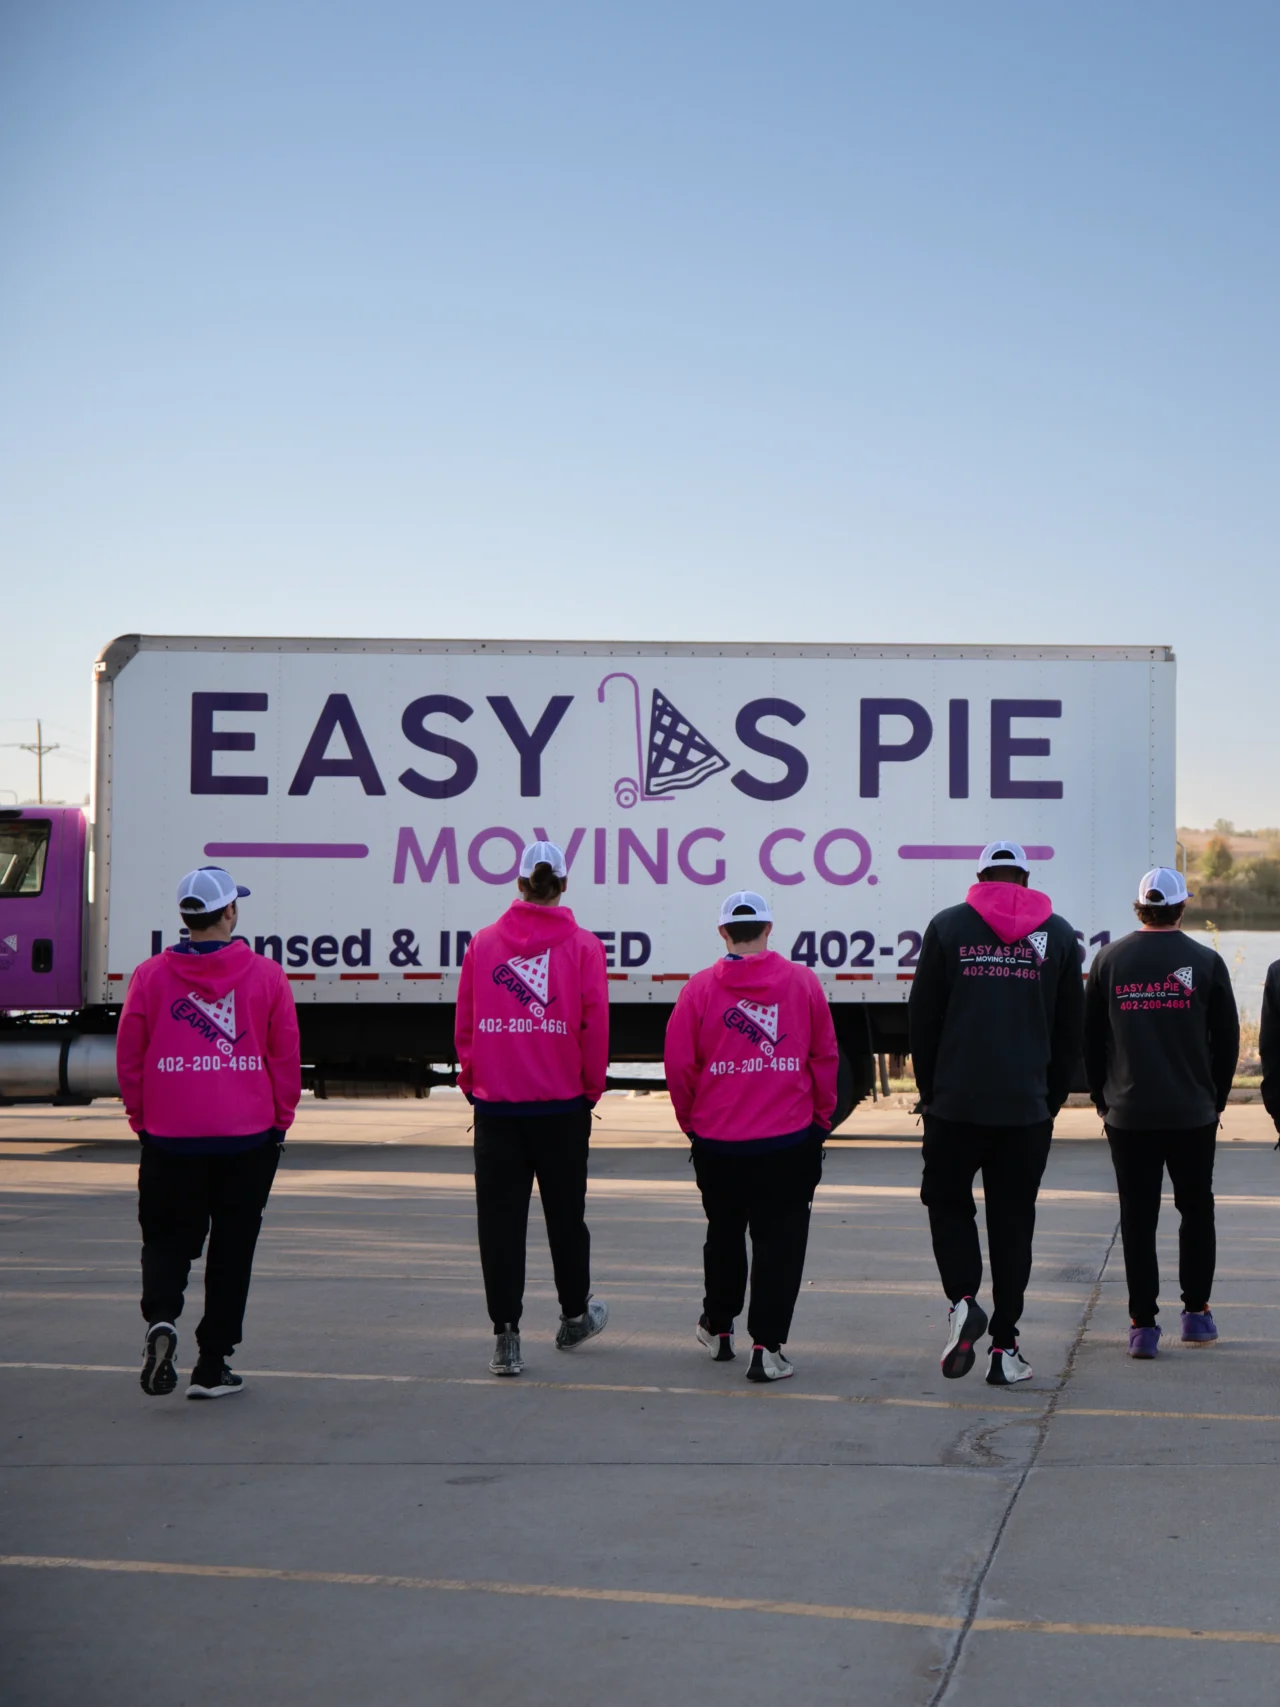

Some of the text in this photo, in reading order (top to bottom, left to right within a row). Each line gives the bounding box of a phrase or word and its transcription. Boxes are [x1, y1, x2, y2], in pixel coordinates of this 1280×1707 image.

[190, 691, 575, 800] EASY
[859, 698, 1064, 800] PIE
[759, 828, 879, 887] CO.
[389, 928, 423, 968] &
[960, 945, 1033, 959] EASY AS PIE
[495, 969, 532, 1007] EAPM
[1115, 982, 1180, 995] EASY AS PIE
[1120, 1000, 1191, 1011] 402-200-4661
[174, 1003, 219, 1043] EAPM
[478, 1018, 568, 1035] 402-200-4661
[727, 1011, 763, 1046] EAPM
[157, 1055, 263, 1073] 402-200-4661
[709, 1057, 800, 1076] 402-200-4661
